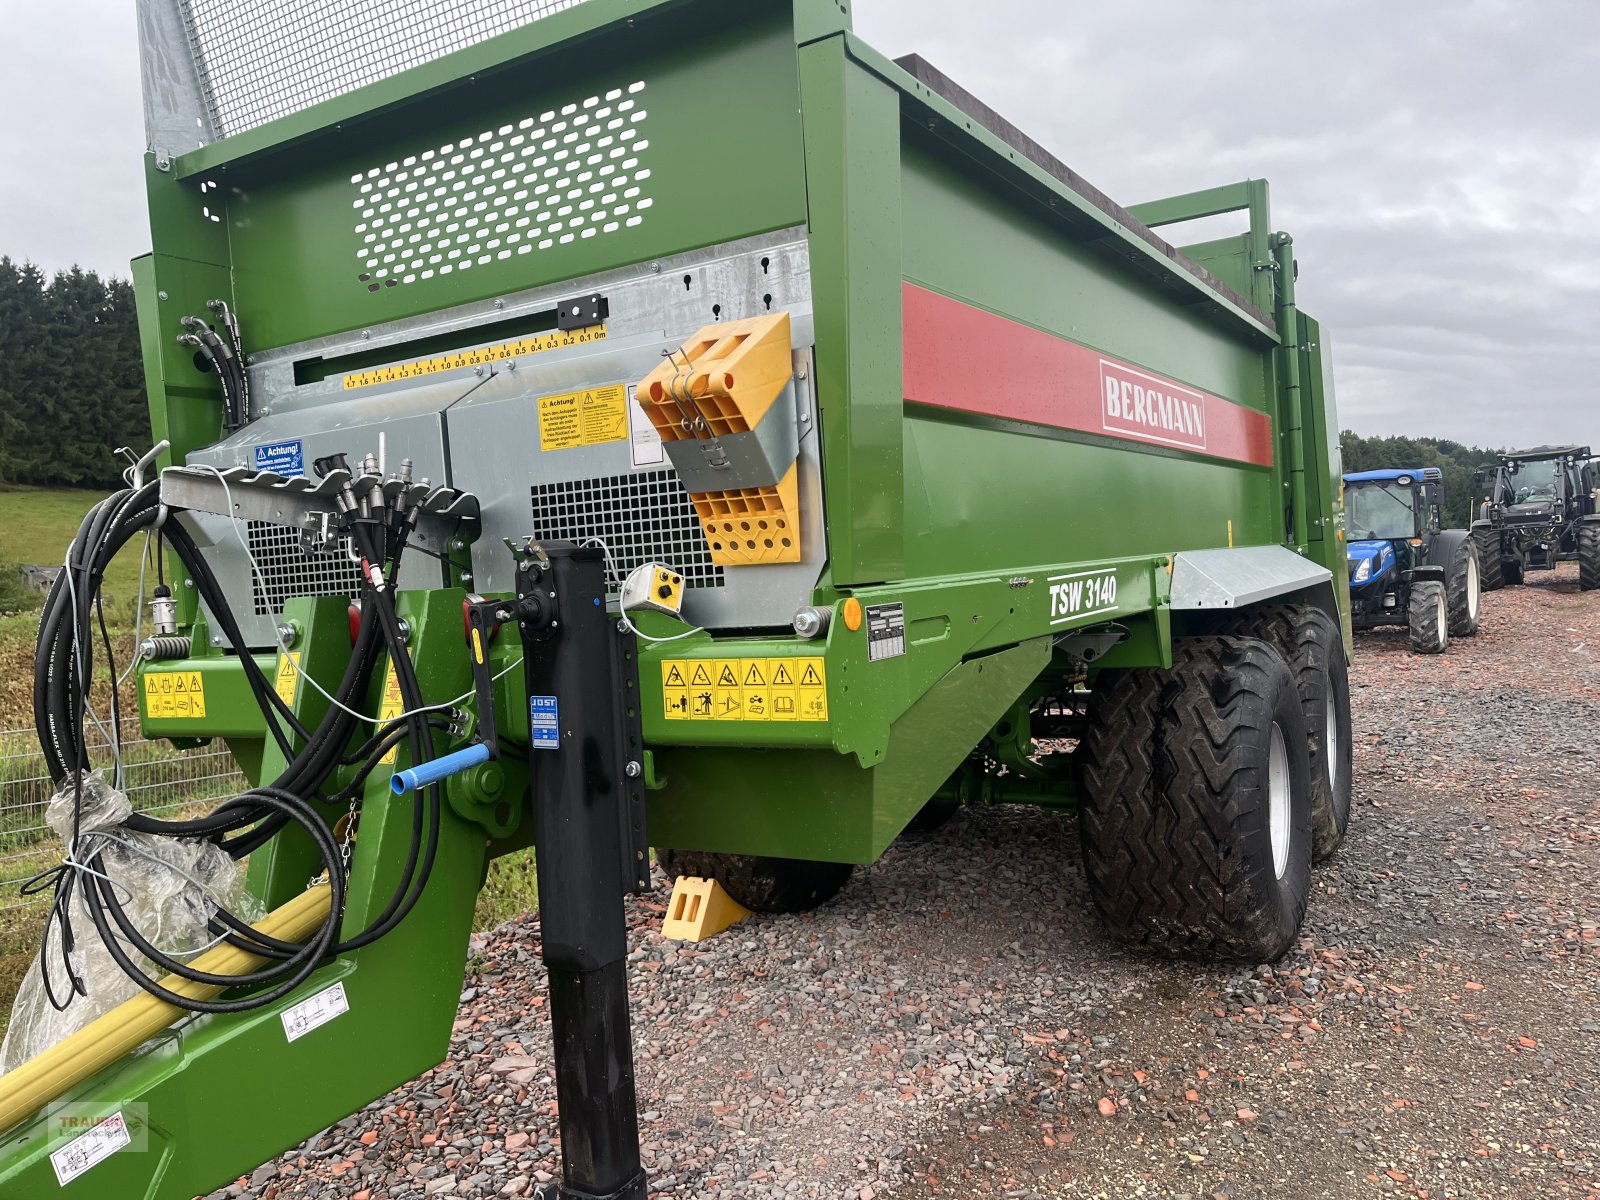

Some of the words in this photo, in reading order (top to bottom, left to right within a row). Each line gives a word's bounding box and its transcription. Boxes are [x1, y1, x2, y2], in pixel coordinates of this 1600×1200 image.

[531, 344, 542, 352] 0.4
[564, 337, 574, 346] 0.2
[580, 334, 591, 342] 0.1
[550, 397, 575, 406] Achtung!
[1105, 375, 1203, 438] BERGMANN
[268, 443, 298, 457] Achtung!
[1049, 580, 1083, 616] TSW
[1085, 575, 1117, 609] 3140
[48, 714, 60, 748] HANSA-FLEX
